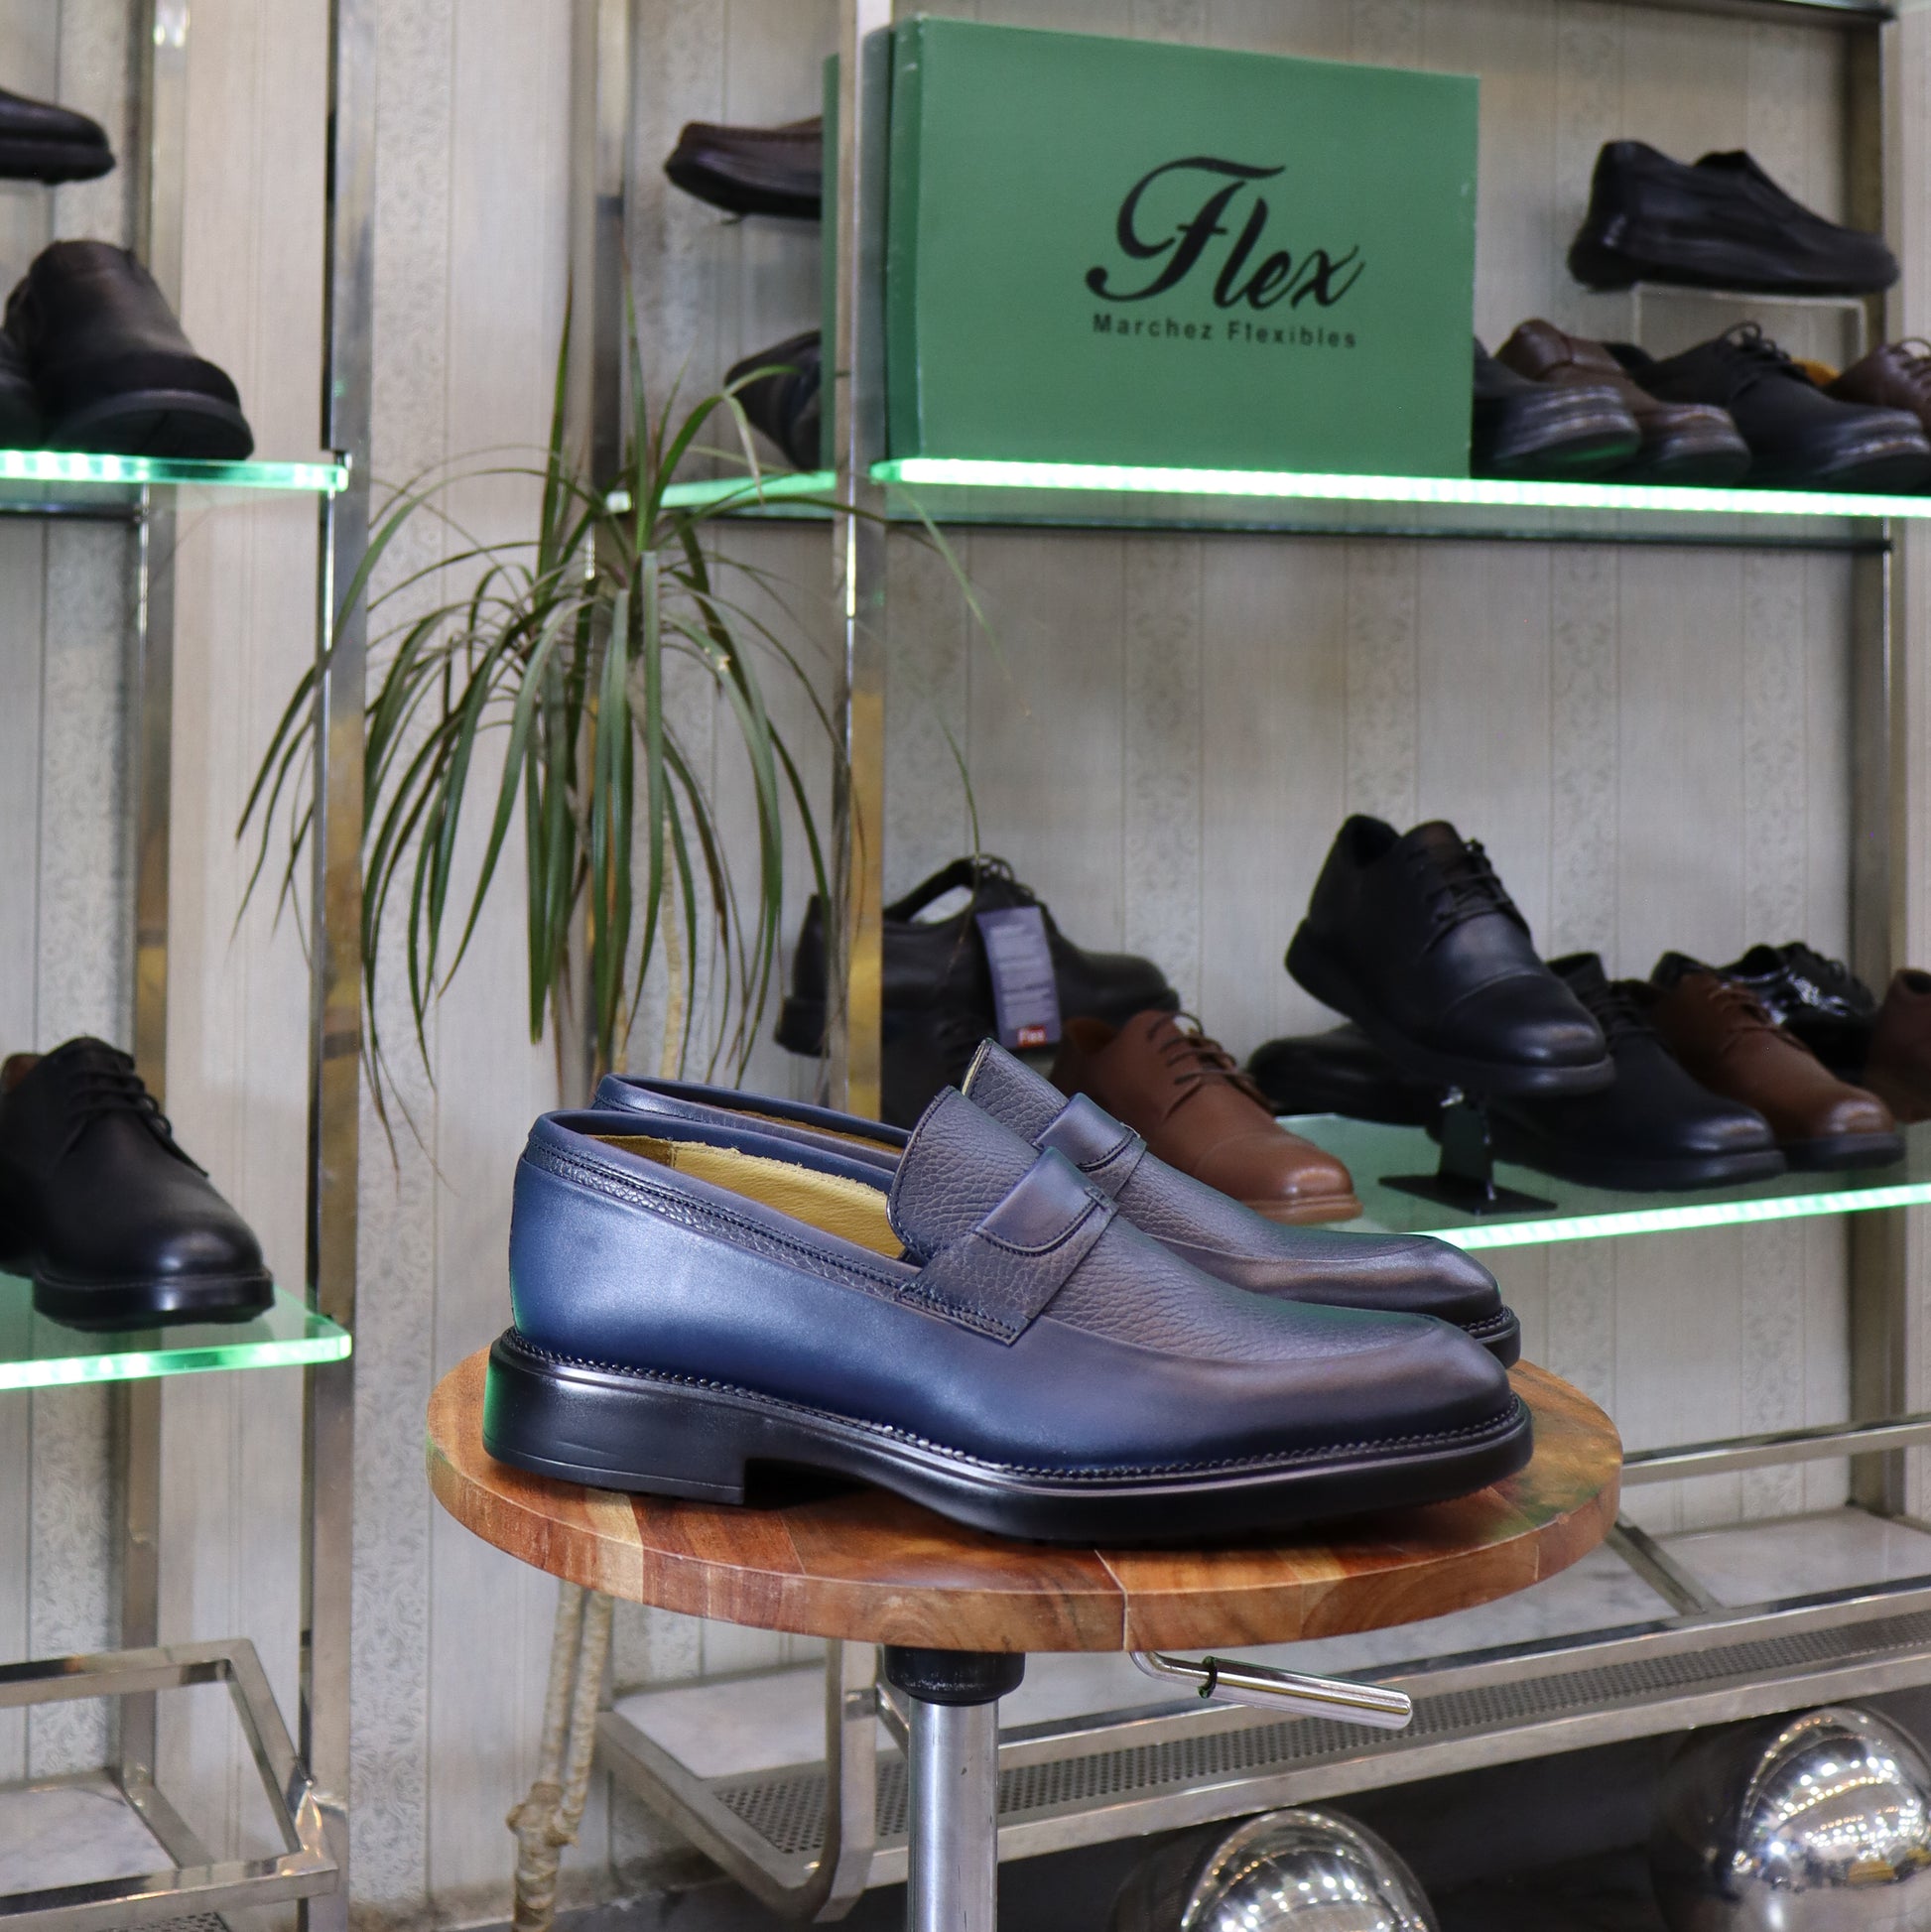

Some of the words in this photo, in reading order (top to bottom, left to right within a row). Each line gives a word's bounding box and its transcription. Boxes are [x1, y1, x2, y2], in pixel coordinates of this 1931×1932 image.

[1085, 156, 1364, 310] Flex
[1093, 314, 1213, 340] Marchez
[1227, 320, 1356, 348] Flexibles
